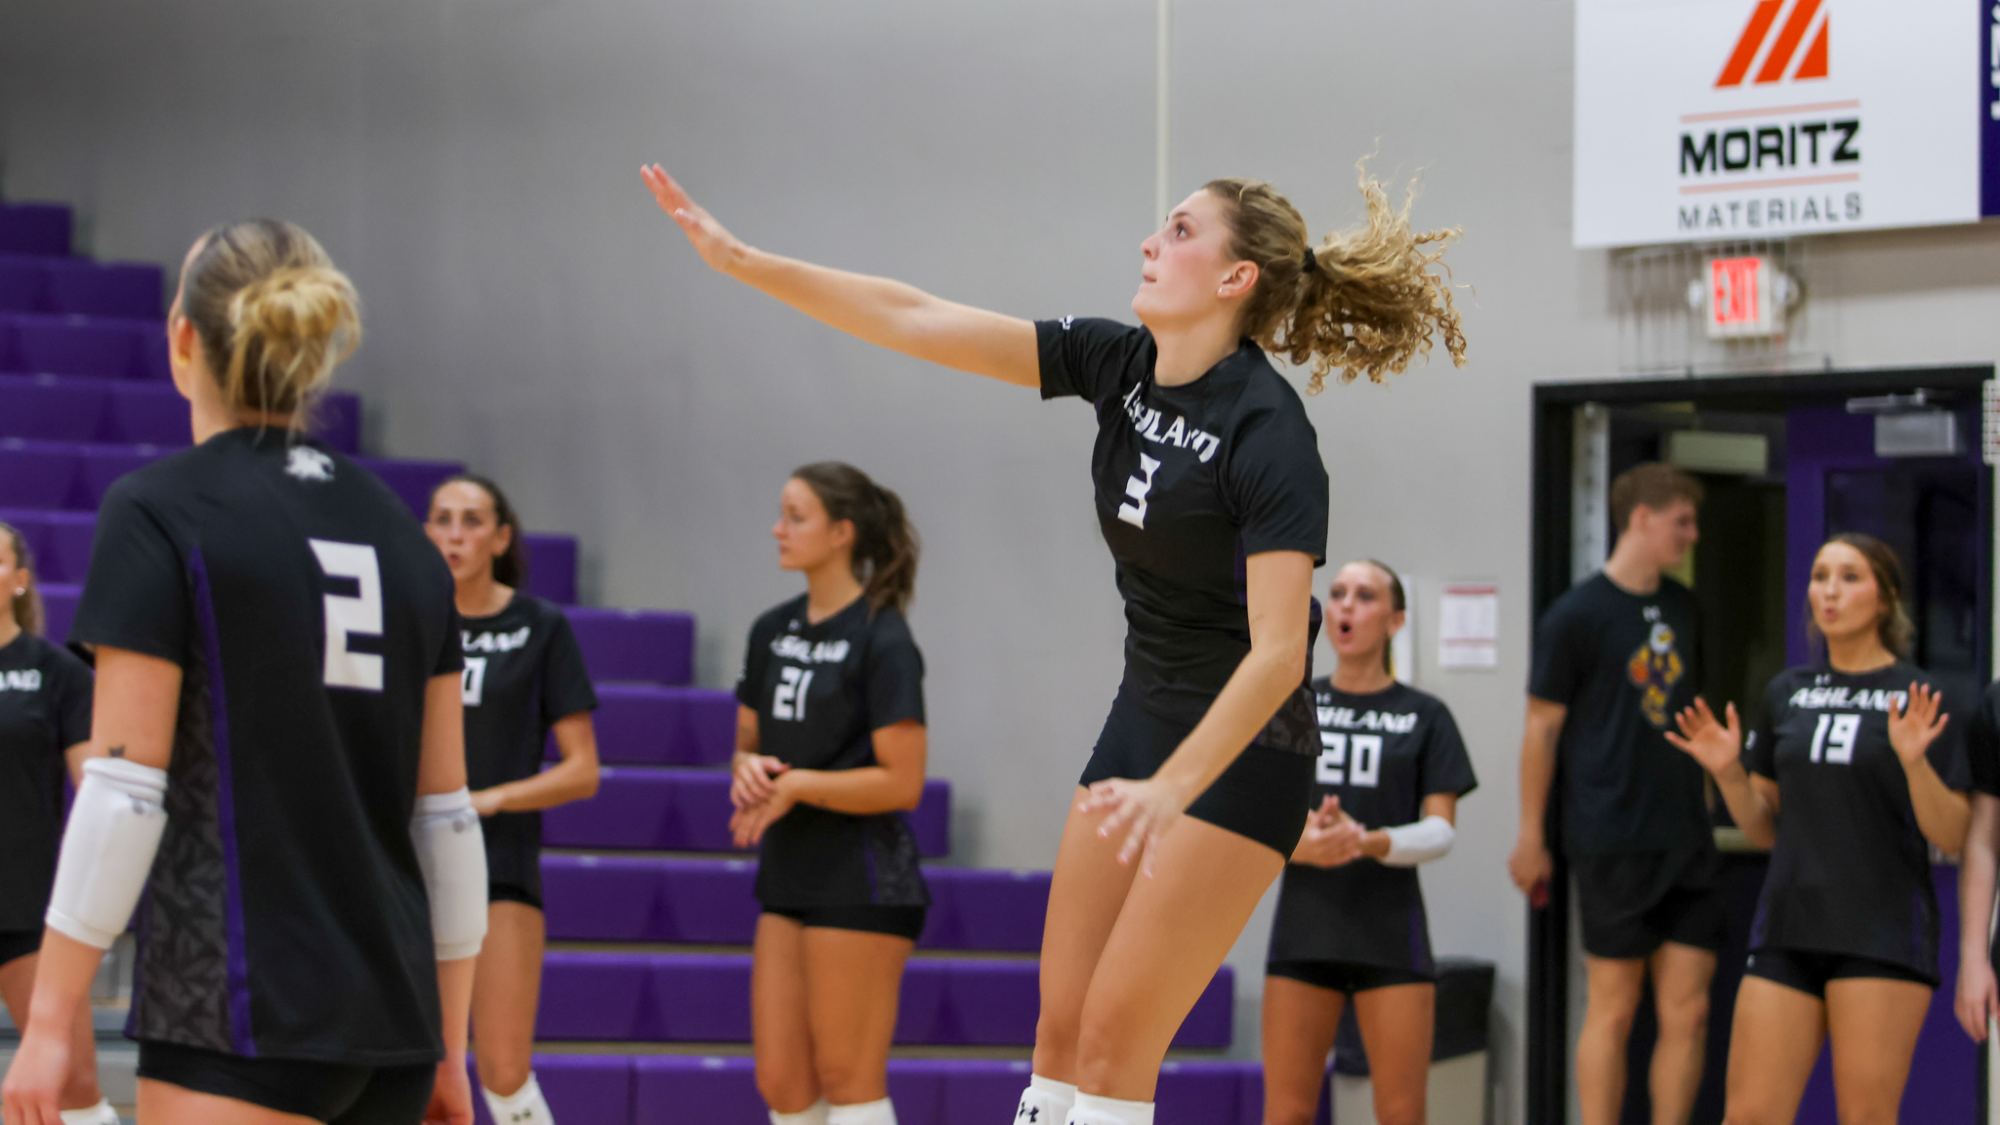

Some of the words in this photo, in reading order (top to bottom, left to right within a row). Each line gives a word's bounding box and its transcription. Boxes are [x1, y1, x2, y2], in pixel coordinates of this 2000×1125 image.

[1680, 120, 1860, 174] MORITZ
[1678, 193, 1862, 231] MATERIALS
[1712, 257, 1761, 325] EXIT
[1117, 452, 1161, 530] 3
[308, 537, 384, 692] 2
[773, 666, 814, 721] 21
[1316, 705, 1418, 734] SHLAND
[1316, 731, 1383, 787] 20
[1809, 713, 1861, 764] 19
